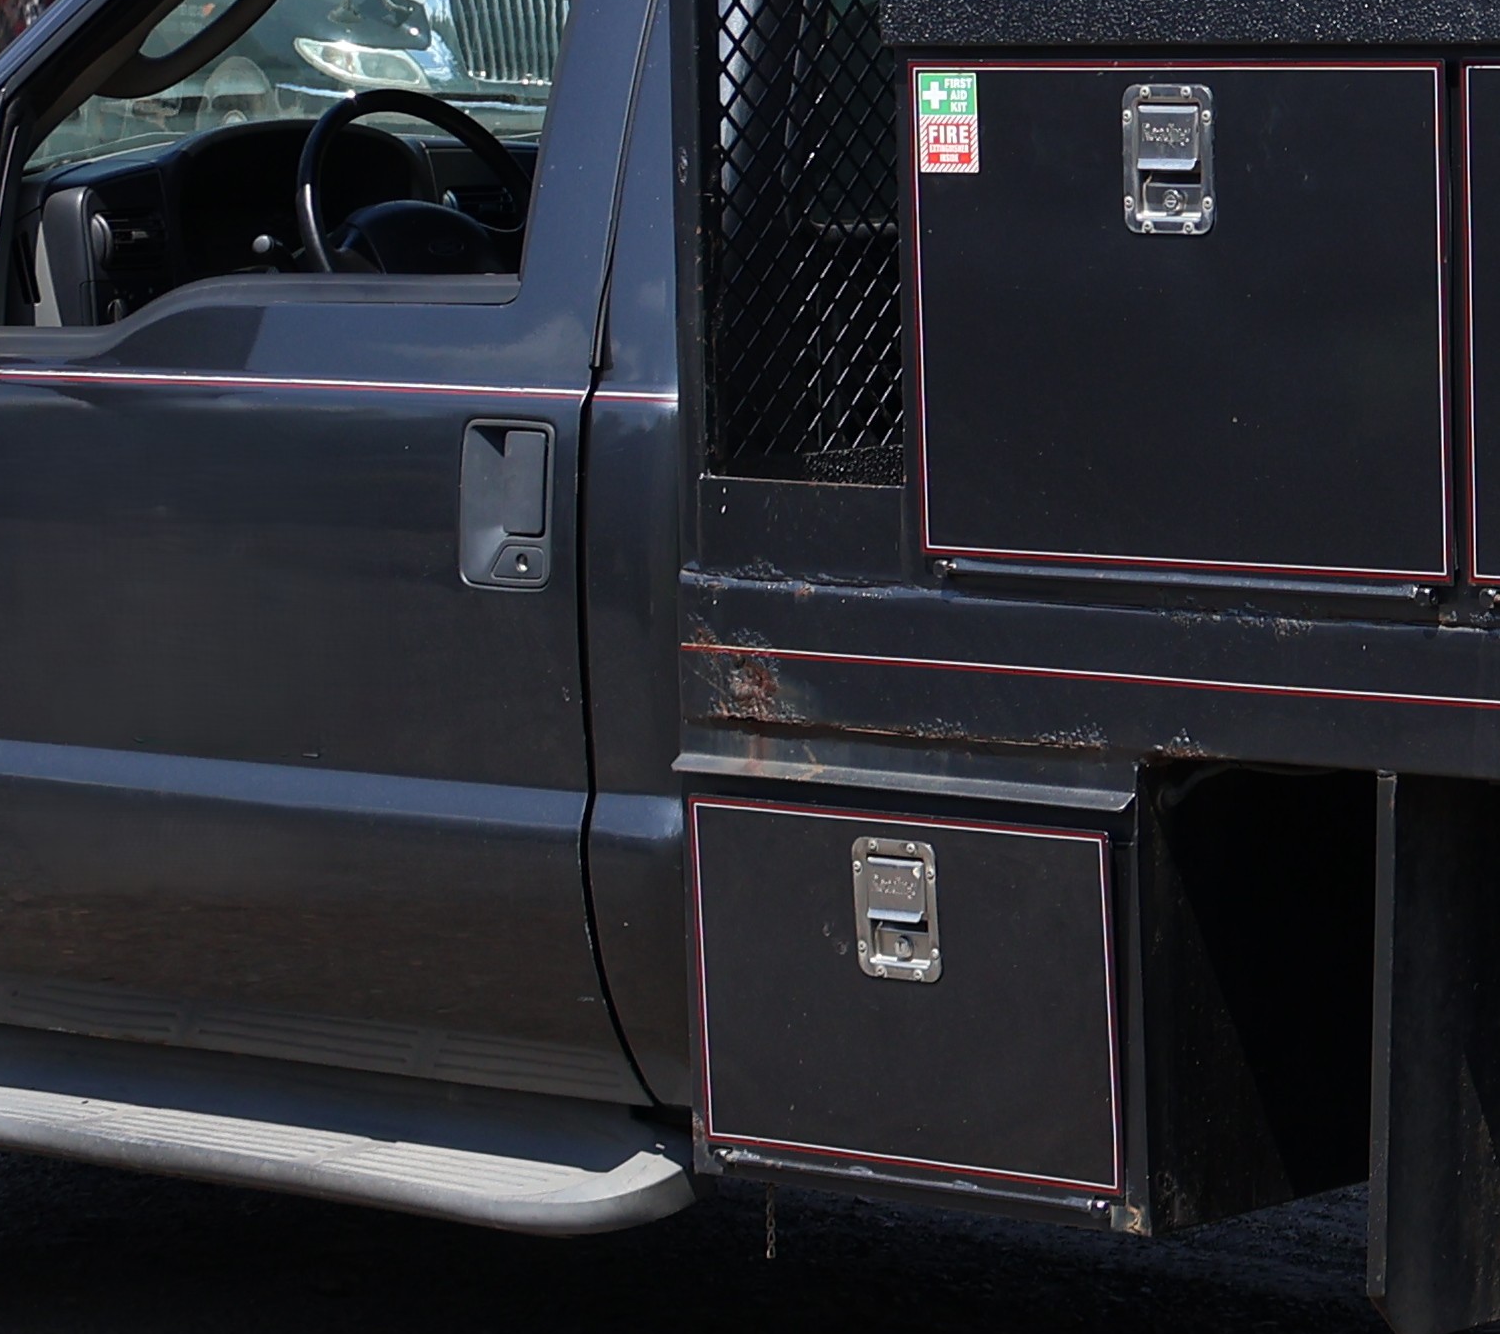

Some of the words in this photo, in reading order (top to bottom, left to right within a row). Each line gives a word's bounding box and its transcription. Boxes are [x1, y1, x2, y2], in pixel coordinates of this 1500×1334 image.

[944, 78, 973, 89] FIRST
[950, 89, 968, 101] AID
[950, 101, 968, 113] KIT
[928, 125, 970, 144] FIRE
